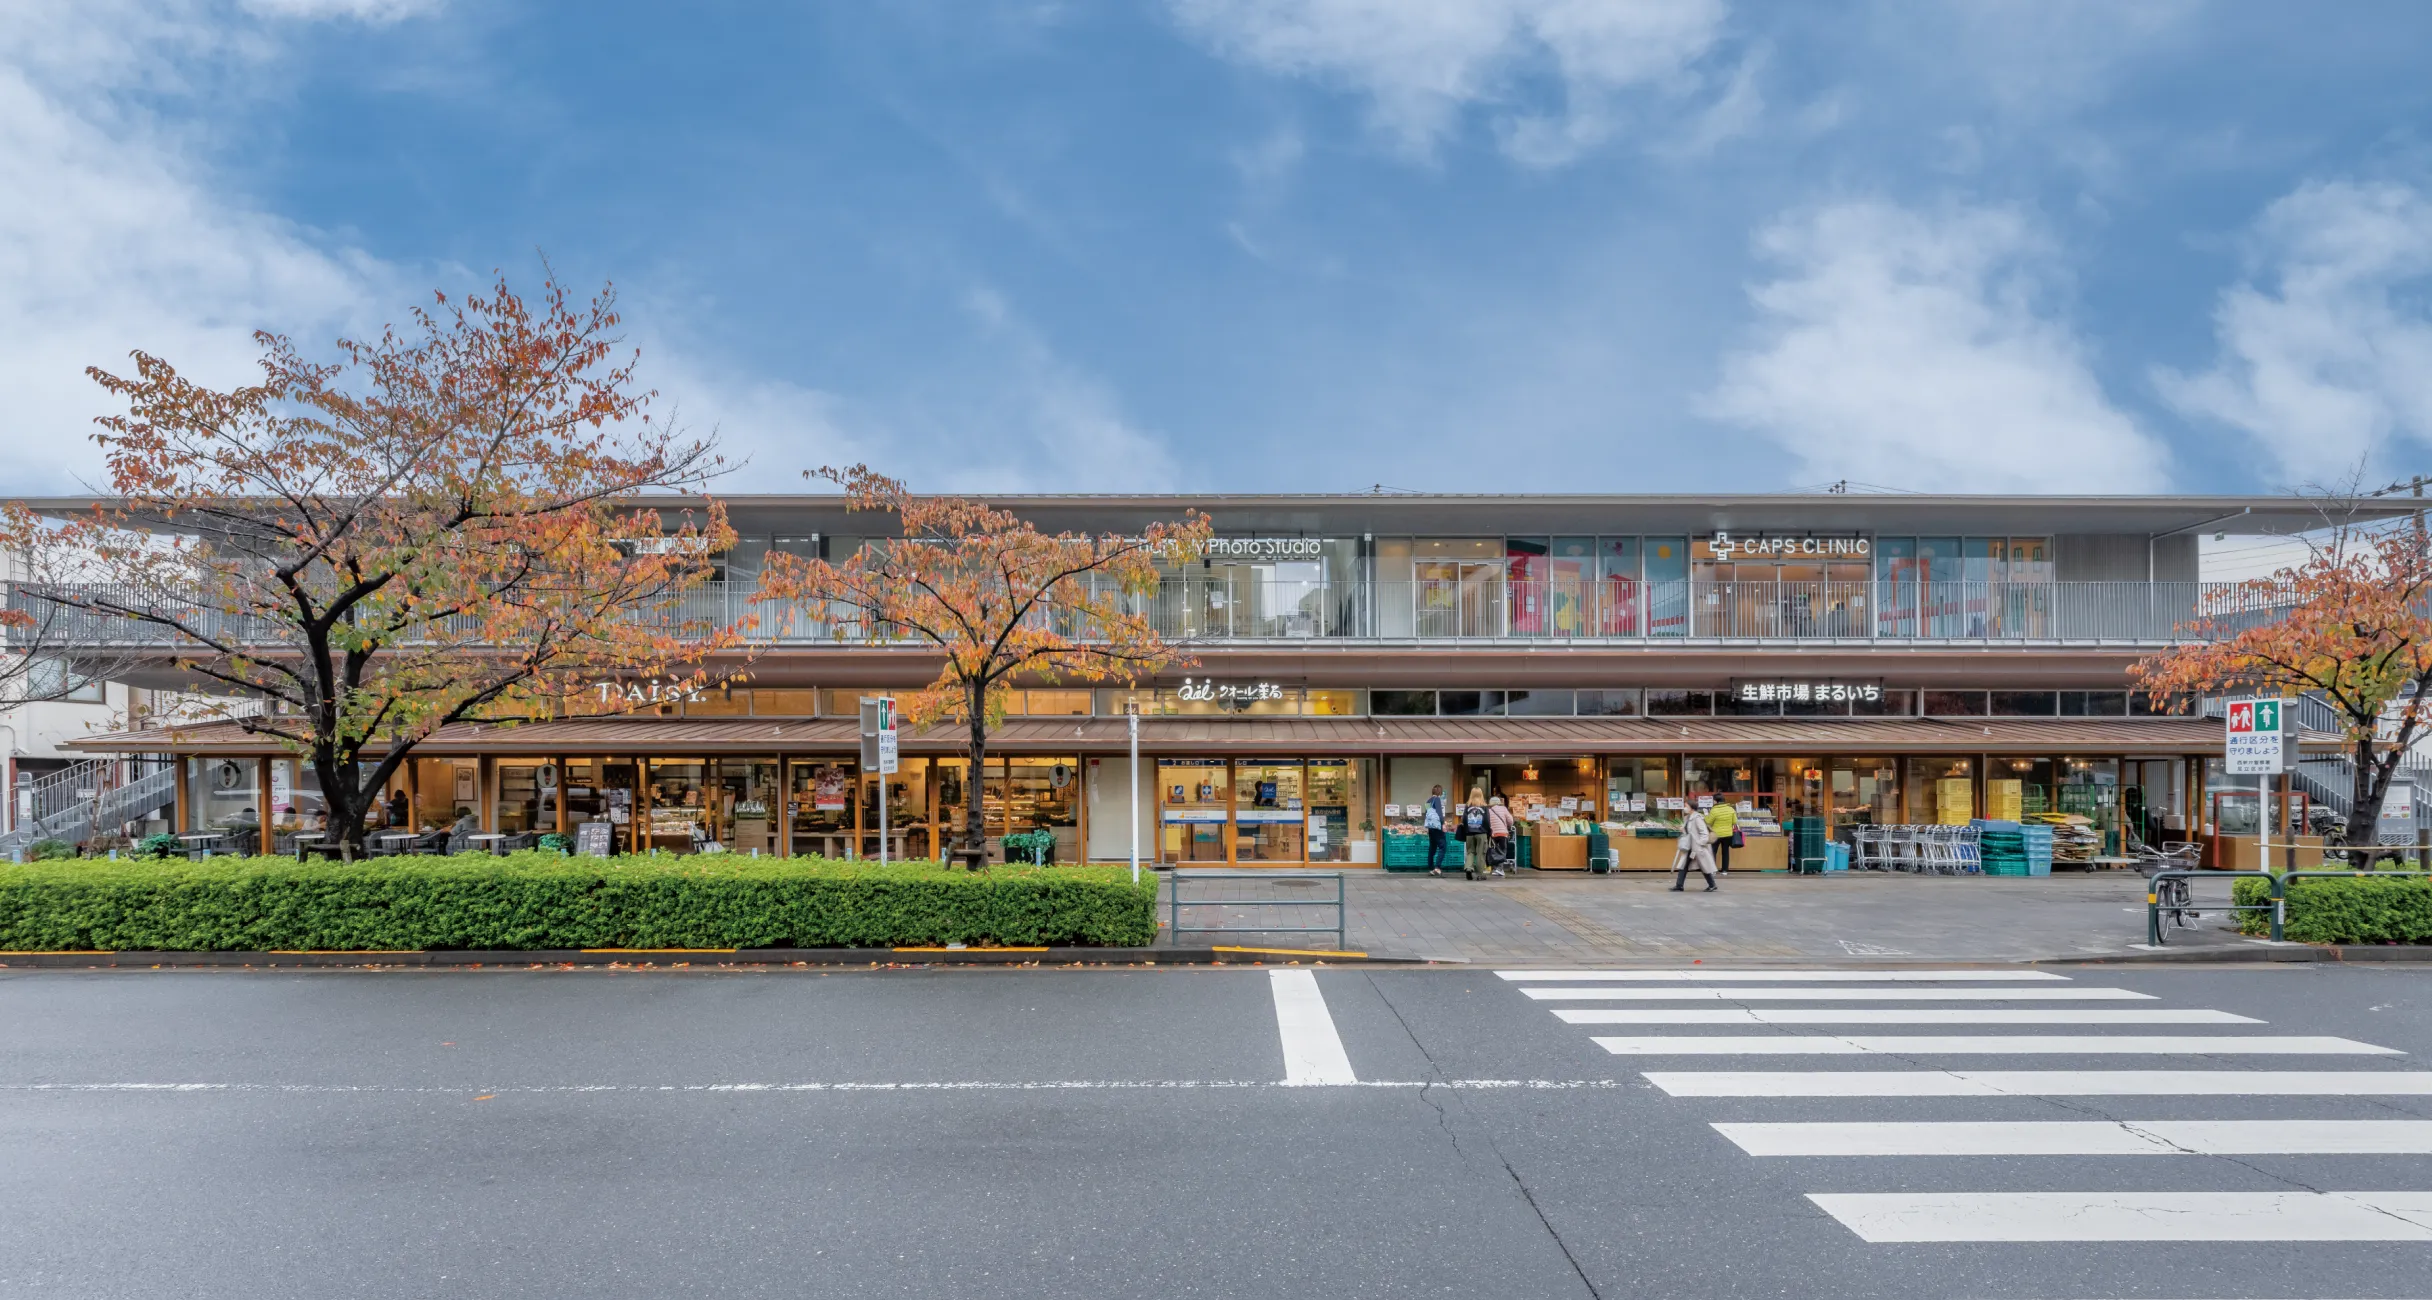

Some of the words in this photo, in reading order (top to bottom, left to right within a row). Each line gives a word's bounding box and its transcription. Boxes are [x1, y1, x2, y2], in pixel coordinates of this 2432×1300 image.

[1209, 538, 1260, 554] Photo
[1265, 538, 1321, 554] Studio
[1744, 538, 1796, 554] CAPS
[1802, 538, 1868, 554] CLINIC
[1219, 682, 1282, 700] クオール薬局
[1742, 684, 1809, 701] 生鮮市場
[1815, 684, 1879, 701] まるいち
[2229, 736, 2279, 744] 通行区分を
[2229, 747, 2279, 755] 守りましょう
